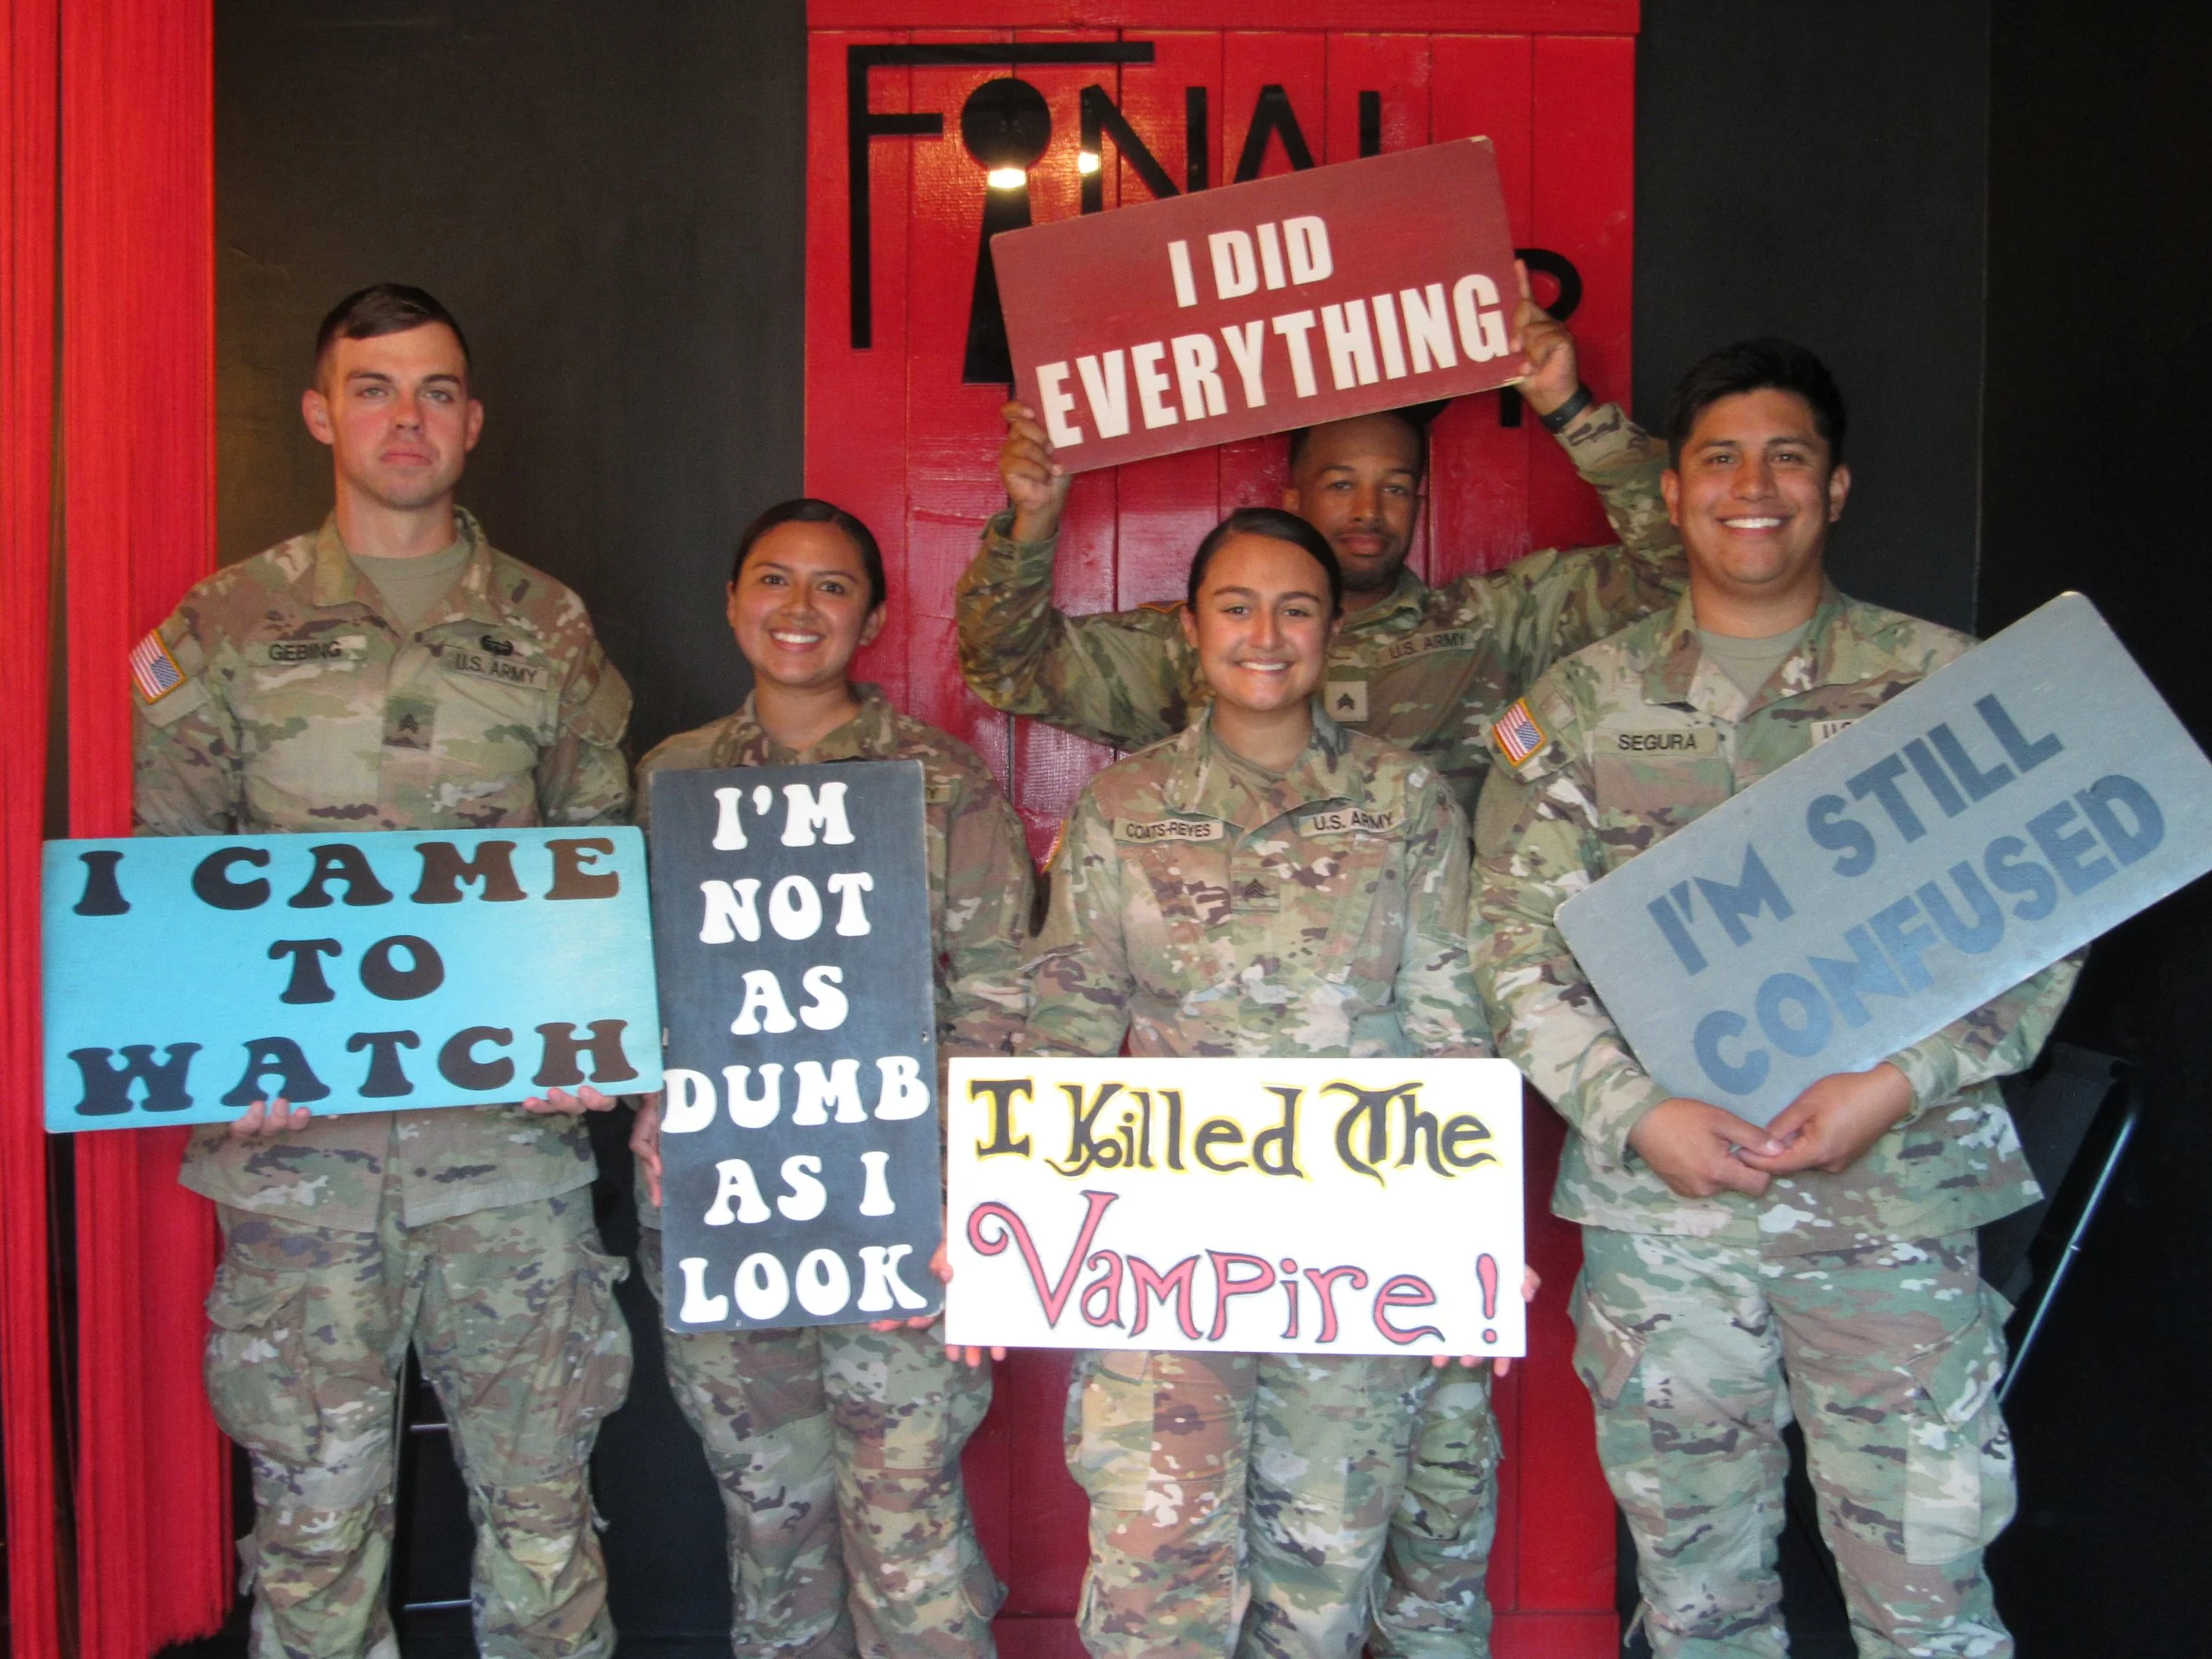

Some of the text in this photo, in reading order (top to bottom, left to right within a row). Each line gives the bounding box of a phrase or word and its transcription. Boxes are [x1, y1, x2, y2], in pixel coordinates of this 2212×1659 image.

[1167, 215, 1333, 308] I DID
[1034, 273, 1509, 449] EVERYTHING
[455, 653, 538, 684] U.S. ARMY
[1423, 633, 1467, 650] ARMY
[1617, 733, 1697, 750] SEGURA
[711, 782, 856, 850] I'M
[1125, 821, 1210, 840] COATS-REYES
[1313, 810, 1394, 831] U.S. ARMY
[1647, 694, 2065, 975] I'M STILL
[73, 837, 619, 916] I CAME
[699, 872, 874, 944] NOT
[268, 934, 445, 1004] TO
[1694, 774, 2165, 1095] CONFUSED
[730, 965, 849, 1035] AS
[67, 1019, 639, 1117] WATCH
[660, 1056, 931, 1134] DUMB
[969, 1079, 1498, 1187] I Killed The
[703, 1151, 896, 1226] AS I
[679, 1244, 928, 1324] LOOK
